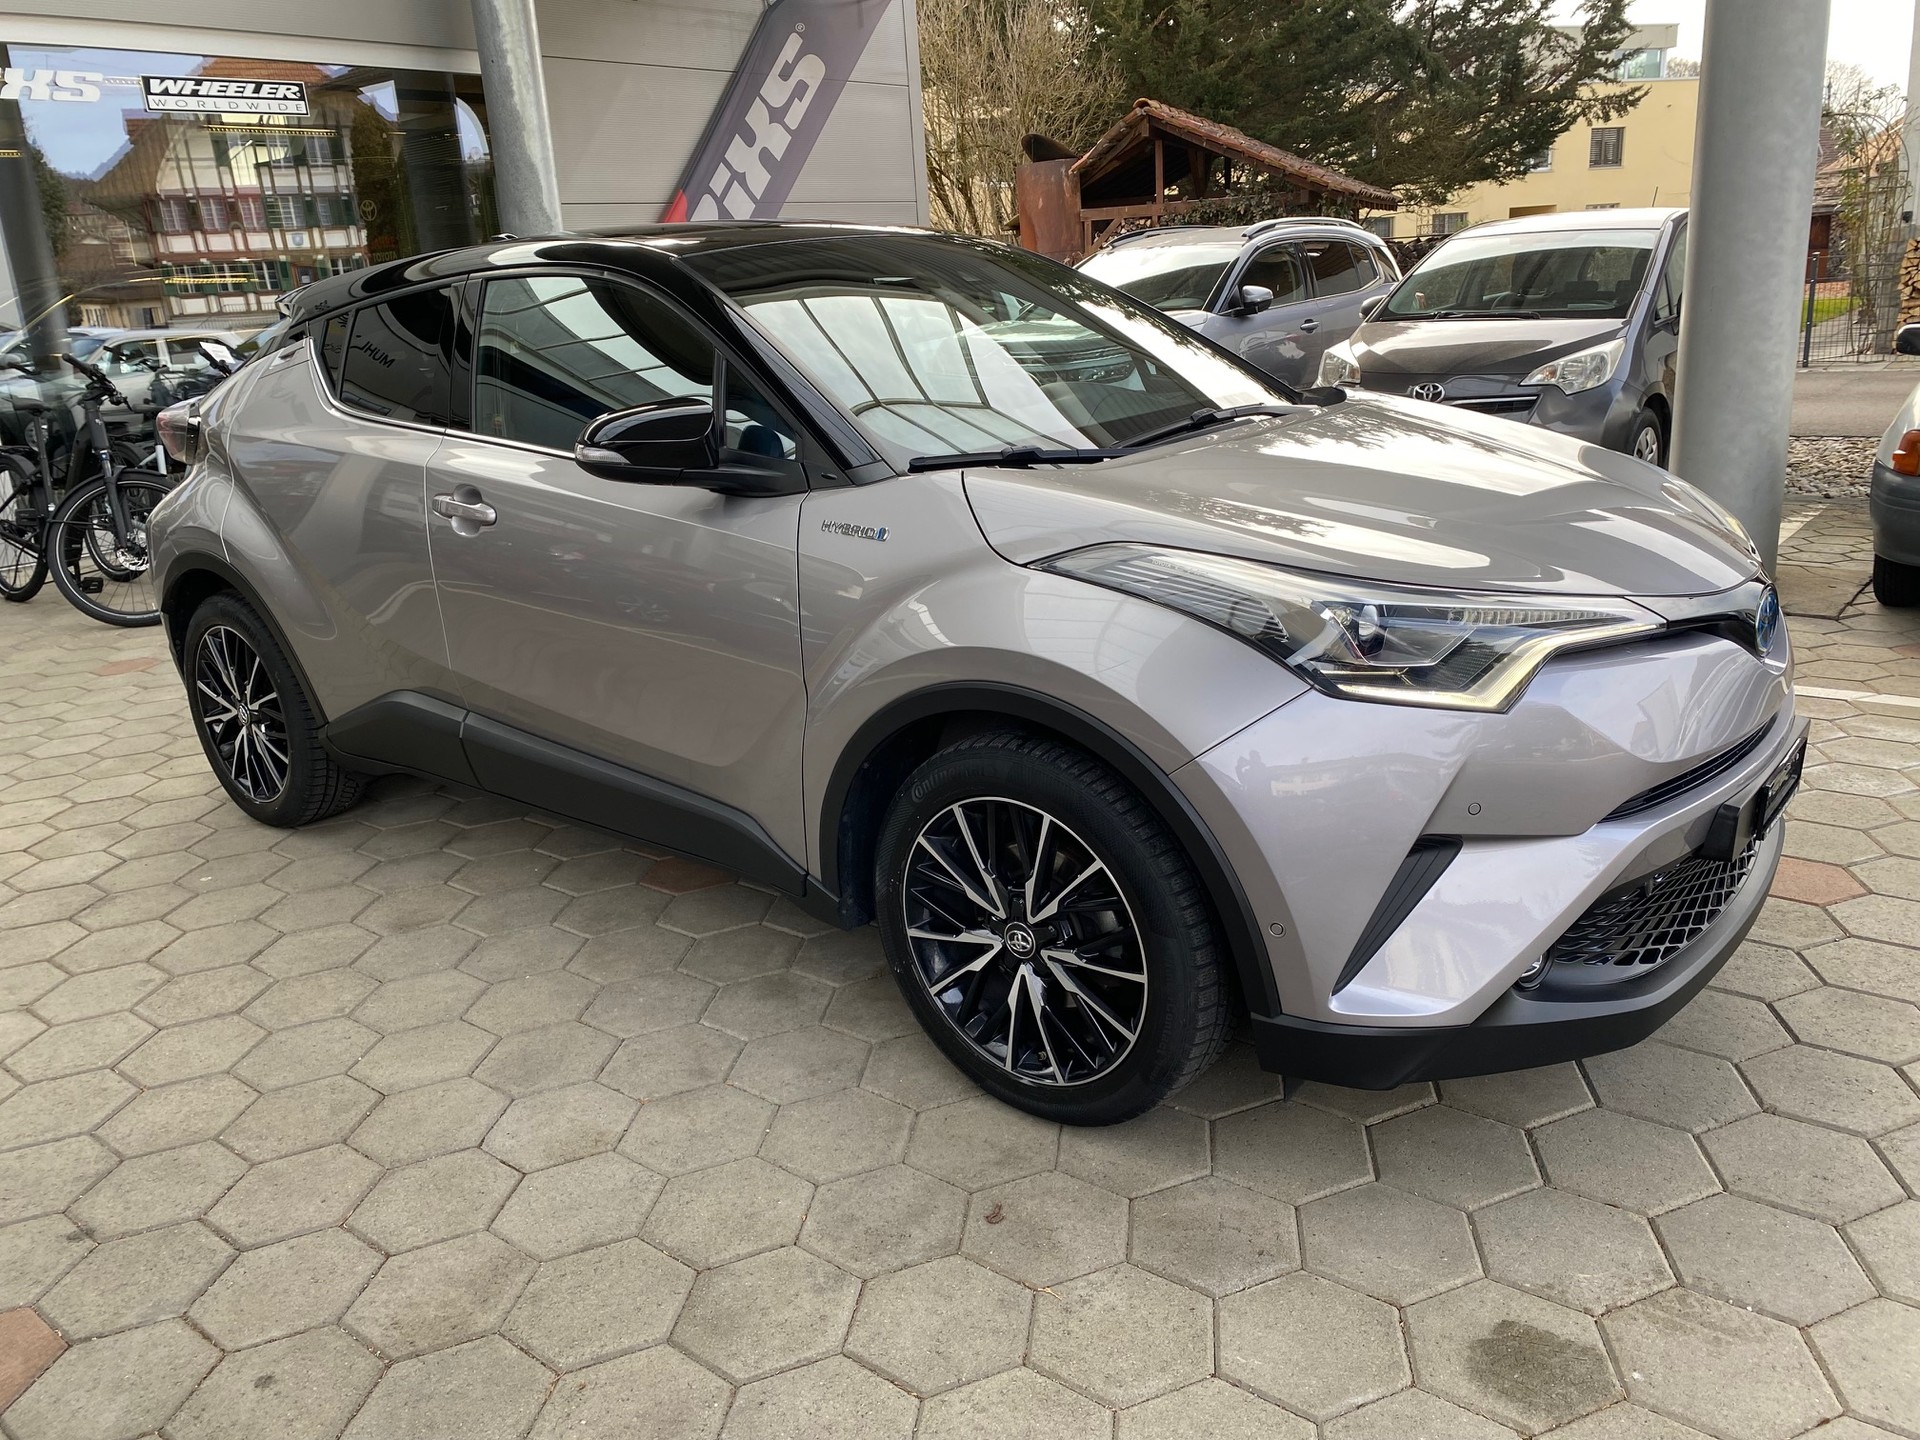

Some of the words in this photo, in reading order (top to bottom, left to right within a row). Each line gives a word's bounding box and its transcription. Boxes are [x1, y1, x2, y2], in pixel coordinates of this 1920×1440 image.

[0, 66, 103, 102] XS
[149, 78, 300, 99] WHEELER
[151, 98, 304, 112] WORLDWIDE
[373, 251, 398, 263] TOYOTA
[821, 519, 877, 540] HYBRID
